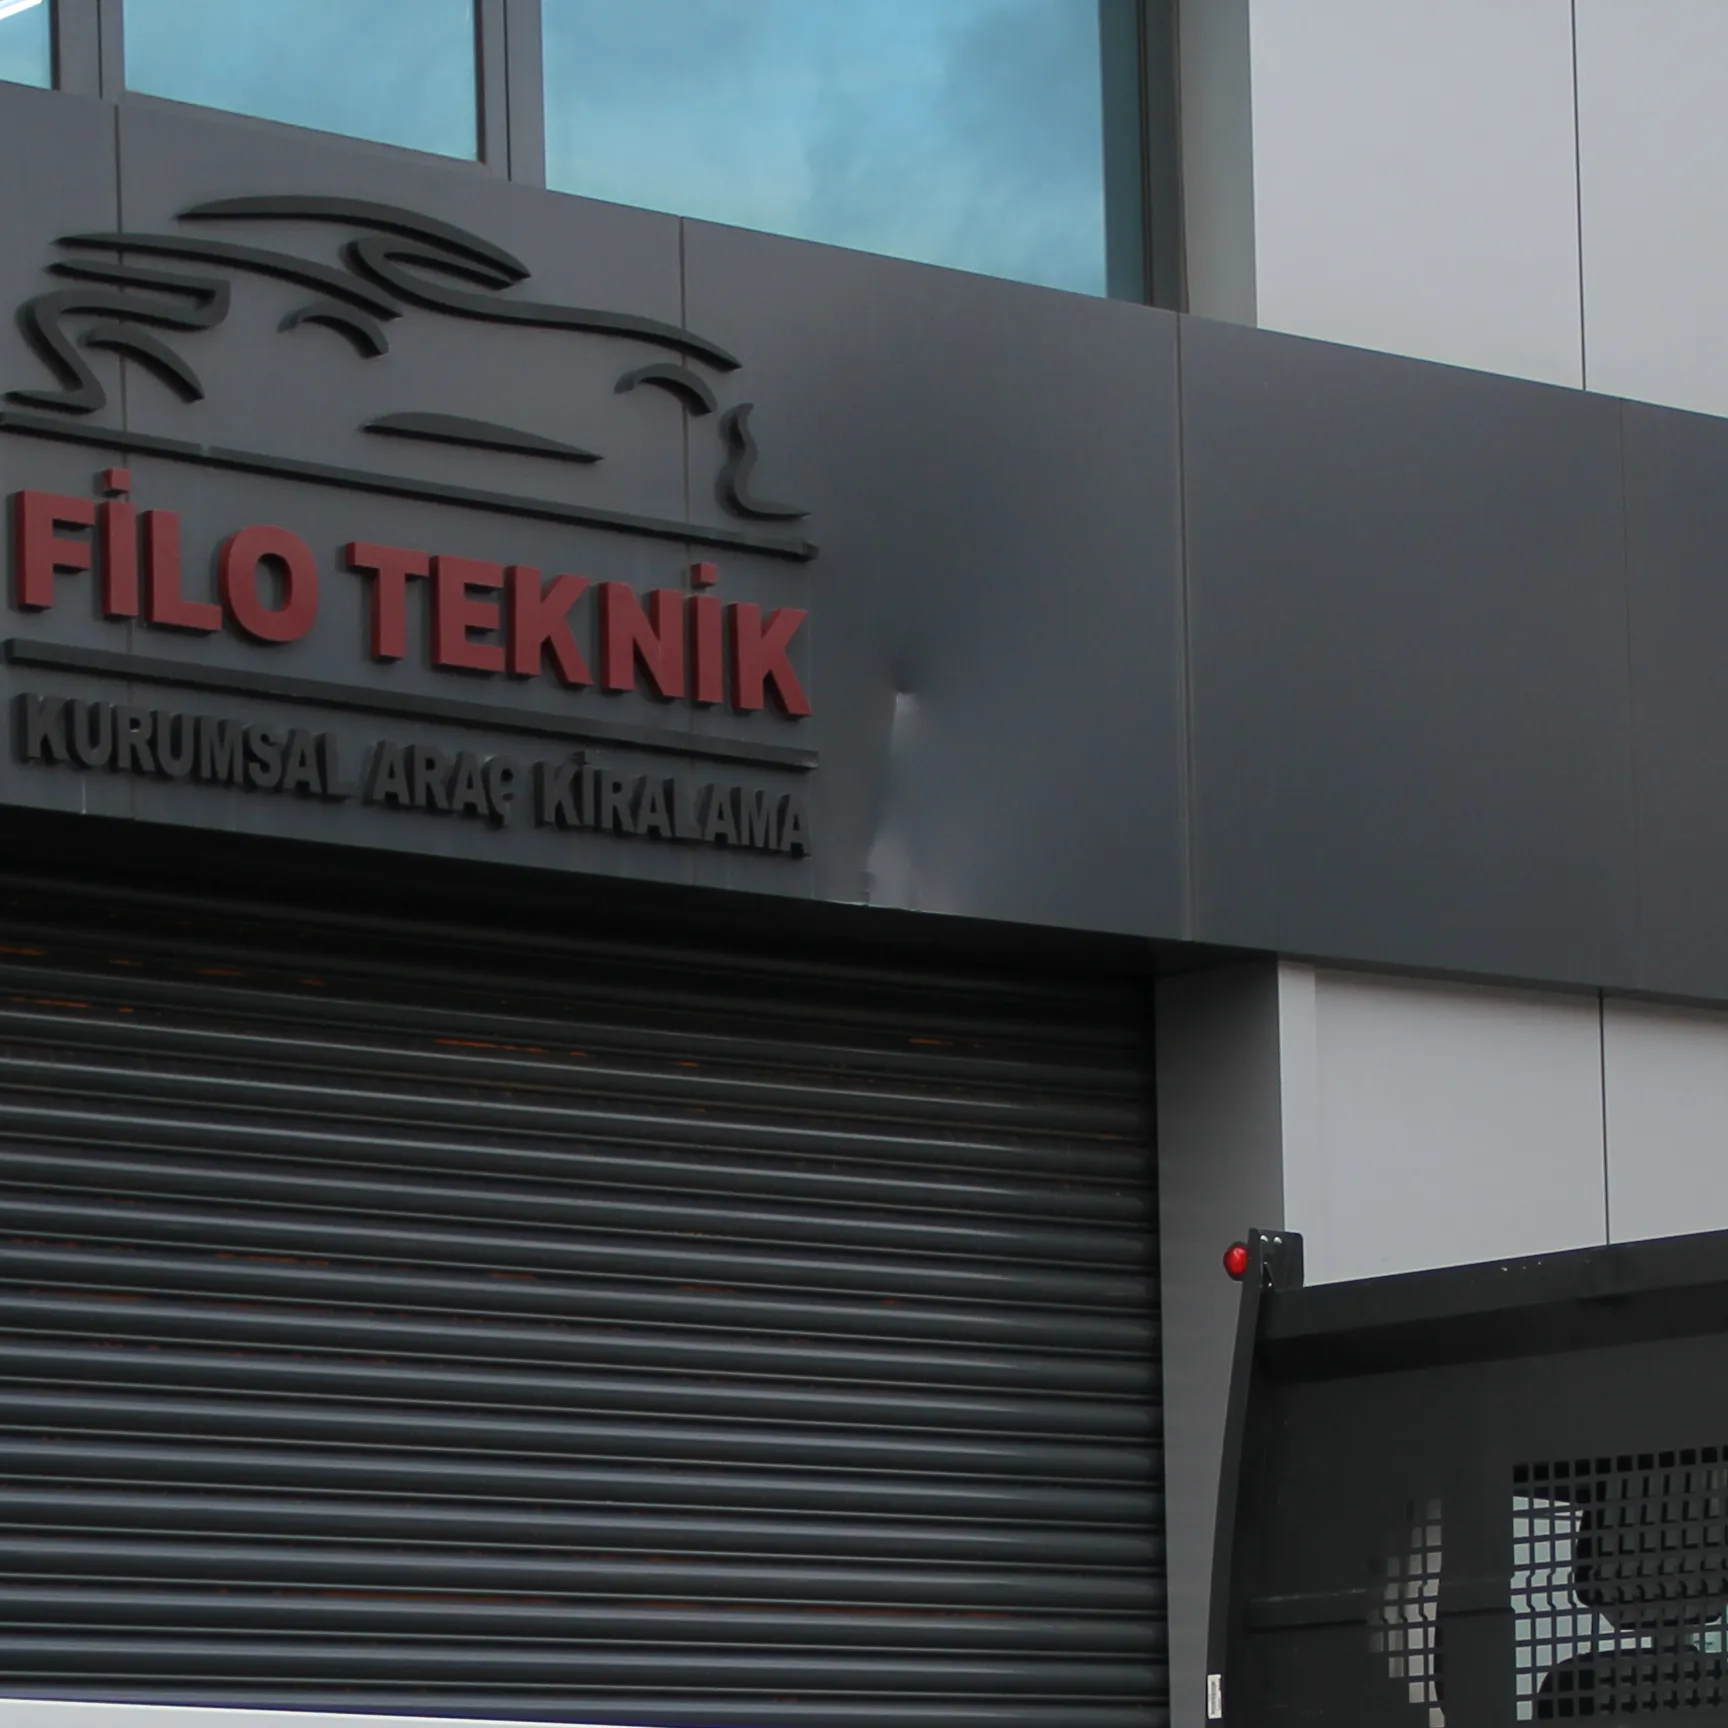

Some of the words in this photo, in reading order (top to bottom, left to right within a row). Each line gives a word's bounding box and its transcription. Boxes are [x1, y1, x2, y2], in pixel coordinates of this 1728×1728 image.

[14, 468, 320, 643] FİLO
[345, 540, 812, 718] TEKNİK
[15, 692, 350, 801] KURUMSAL
[366, 740, 518, 828] ARAÇ
[534, 752, 812, 856] KİRALAMA
